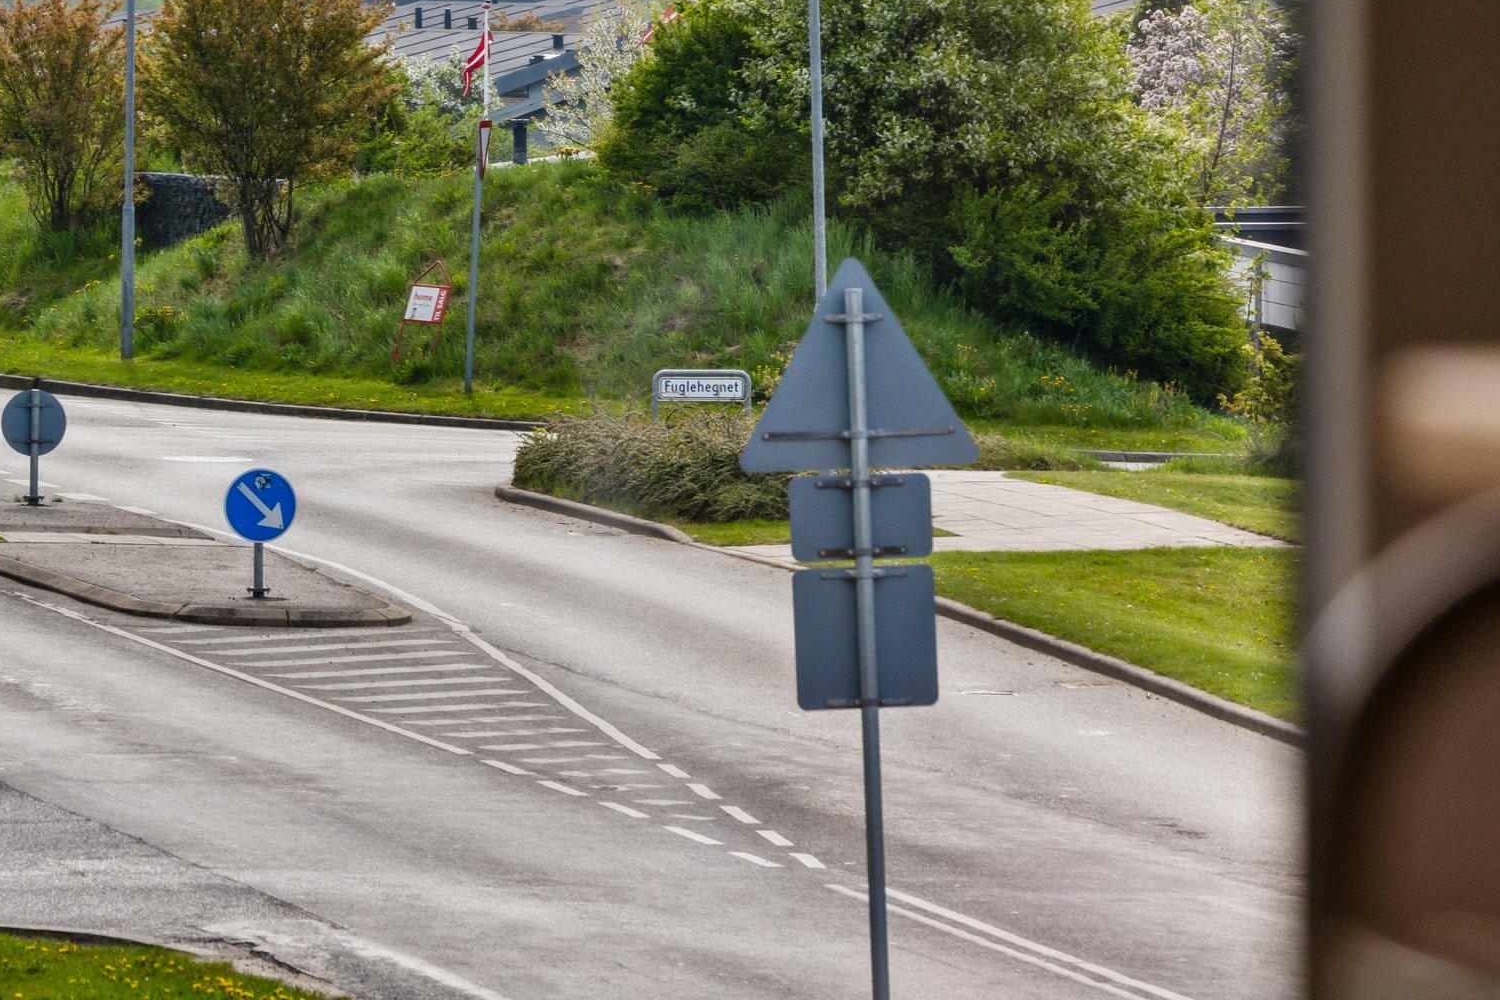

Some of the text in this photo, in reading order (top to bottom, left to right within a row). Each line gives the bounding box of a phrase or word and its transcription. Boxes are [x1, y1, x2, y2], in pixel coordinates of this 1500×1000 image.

[414, 291, 433, 301] home
[433, 291, 447, 320] TIL SALG
[664, 380, 739, 396] Fuglehegnet
